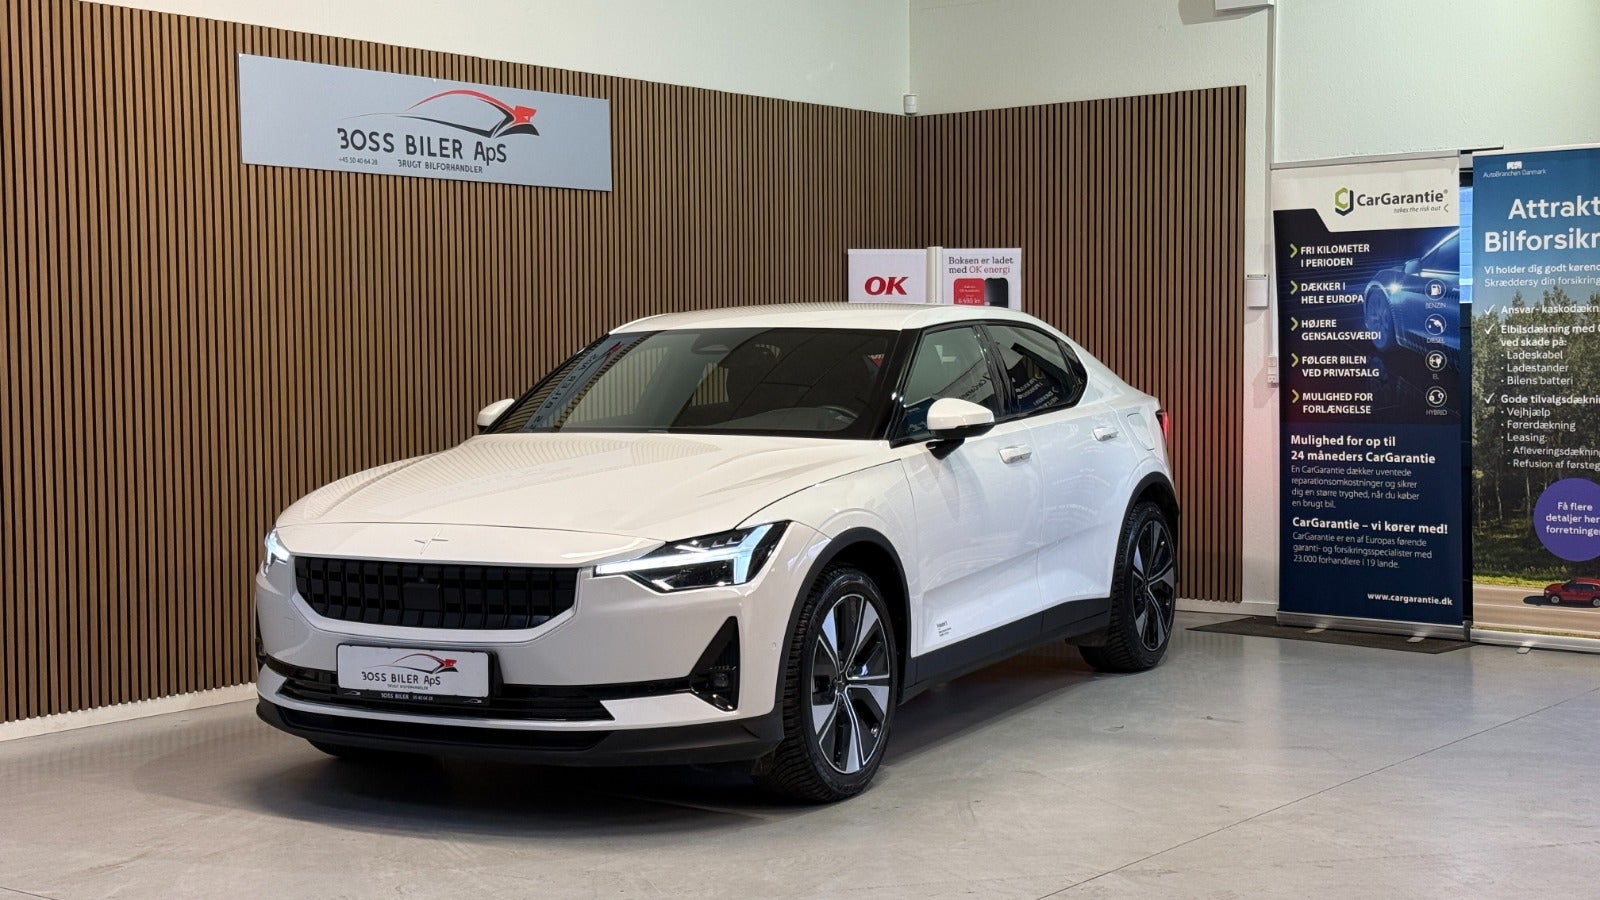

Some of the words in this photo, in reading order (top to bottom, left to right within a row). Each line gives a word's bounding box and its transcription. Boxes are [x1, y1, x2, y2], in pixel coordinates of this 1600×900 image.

[406, 134, 463, 160] BILER
[474, 141, 506, 166] ApS
[424, 161, 482, 174] BILFORHANDLER
[1300, 246, 1314, 254] FRI
[1317, 244, 1370, 254] KILOMETER
[948, 256, 978, 264] Boksen
[992, 256, 1014, 264] ladet
[1306, 258, 1353, 267] PERIODEN
[984, 266, 1010, 275] energi
[1484, 266, 1494, 274] Vi
[1496, 264, 1525, 274] holder
[1528, 264, 1542, 275] dig
[1545, 263, 1567, 274] godt
[864, 276, 908, 296] OK
[1301, 282, 1340, 292] DÆKKER
[1484, 278, 1538, 288] Skræddersy
[1541, 277, 1556, 286] din
[1302, 295, 1324, 304] HELE
[1326, 294, 1364, 304] EUROPA
[1302, 320, 1336, 328] HØJERE
[1501, 325, 1570, 336] Elbilsdækning
[1572, 324, 1595, 332] med
[1302, 332, 1381, 340] GENSALGSVÆRDI
[1501, 338, 1518, 346] ved
[1521, 338, 1550, 346] skade
[1552, 337, 1567, 348] på:
[1302, 356, 1338, 364] FØLGER
[1340, 356, 1366, 364] BILEN
[1507, 351, 1563, 360] Ladeskabel
[1302, 368, 1320, 377] VED
[1324, 368, 1379, 378] PRIVATSALG
[1507, 364, 1569, 372] Ladestander
[1507, 376, 1538, 385] Bilens
[1540, 376, 1574, 385] batteri
[1302, 392, 1352, 401] MULIGHED
[1354, 392, 1373, 400] FOR
[1501, 394, 1528, 404] Gode
[1303, 405, 1371, 414] FORLÆNGELSE
[1507, 407, 1550, 418] Vejhjælp
[1507, 420, 1576, 432] Førerdækning
[1291, 435, 1344, 448] Mulighed
[1346, 436, 1363, 446] for
[1366, 438, 1380, 448] op
[1384, 436, 1396, 446] til
[1507, 433, 1548, 444] Leasing:
[1292, 451, 1304, 460] 24
[1308, 450, 1363, 462] måneders
[1366, 452, 1436, 464] CarGarantie
[1513, 460, 1553, 468] Refusion
[1556, 460, 1564, 468] af
[1302, 466, 1345, 474] CarGarantie
[1346, 466, 1374, 475] dækker
[1376, 468, 1412, 476] uventede
[1292, 478, 1383, 488] reparationsomkostninger
[1398, 480, 1418, 488] sikrer
[1292, 488, 1304, 498] dig
[1316, 490, 1337, 498] større
[1339, 490, 1370, 499] tryghed,
[1372, 490, 1384, 498] når
[1398, 492, 1419, 500] køber
[1303, 500, 1323, 510] brugt
[1324, 500, 1336, 508] bil.
[1558, 502, 1568, 510] Få
[1570, 502, 1592, 511] flere
[1546, 514, 1582, 524] detaljer
[1292, 517, 1360, 530] CarGarantie
[1371, 522, 1382, 531] vi
[1384, 522, 1415, 532] kører
[1418, 524, 1448, 534] med!
[1292, 532, 1336, 542] CarGarantie
[1366, 536, 1396, 546] Europas
[1397, 538, 1426, 546] førende
[1293, 544, 1321, 553] garanti-
[1334, 546, 1412, 558] forsikringsspecialister
[1294, 555, 1318, 563] 23.000
[1318, 556, 1360, 566] forhandlere
[1377, 560, 1400, 568] lande.
[1368, 593, 1453, 606] www.cargarantie.dk
[391, 674, 418, 684] BILER
[424, 676, 440, 688] ApS
